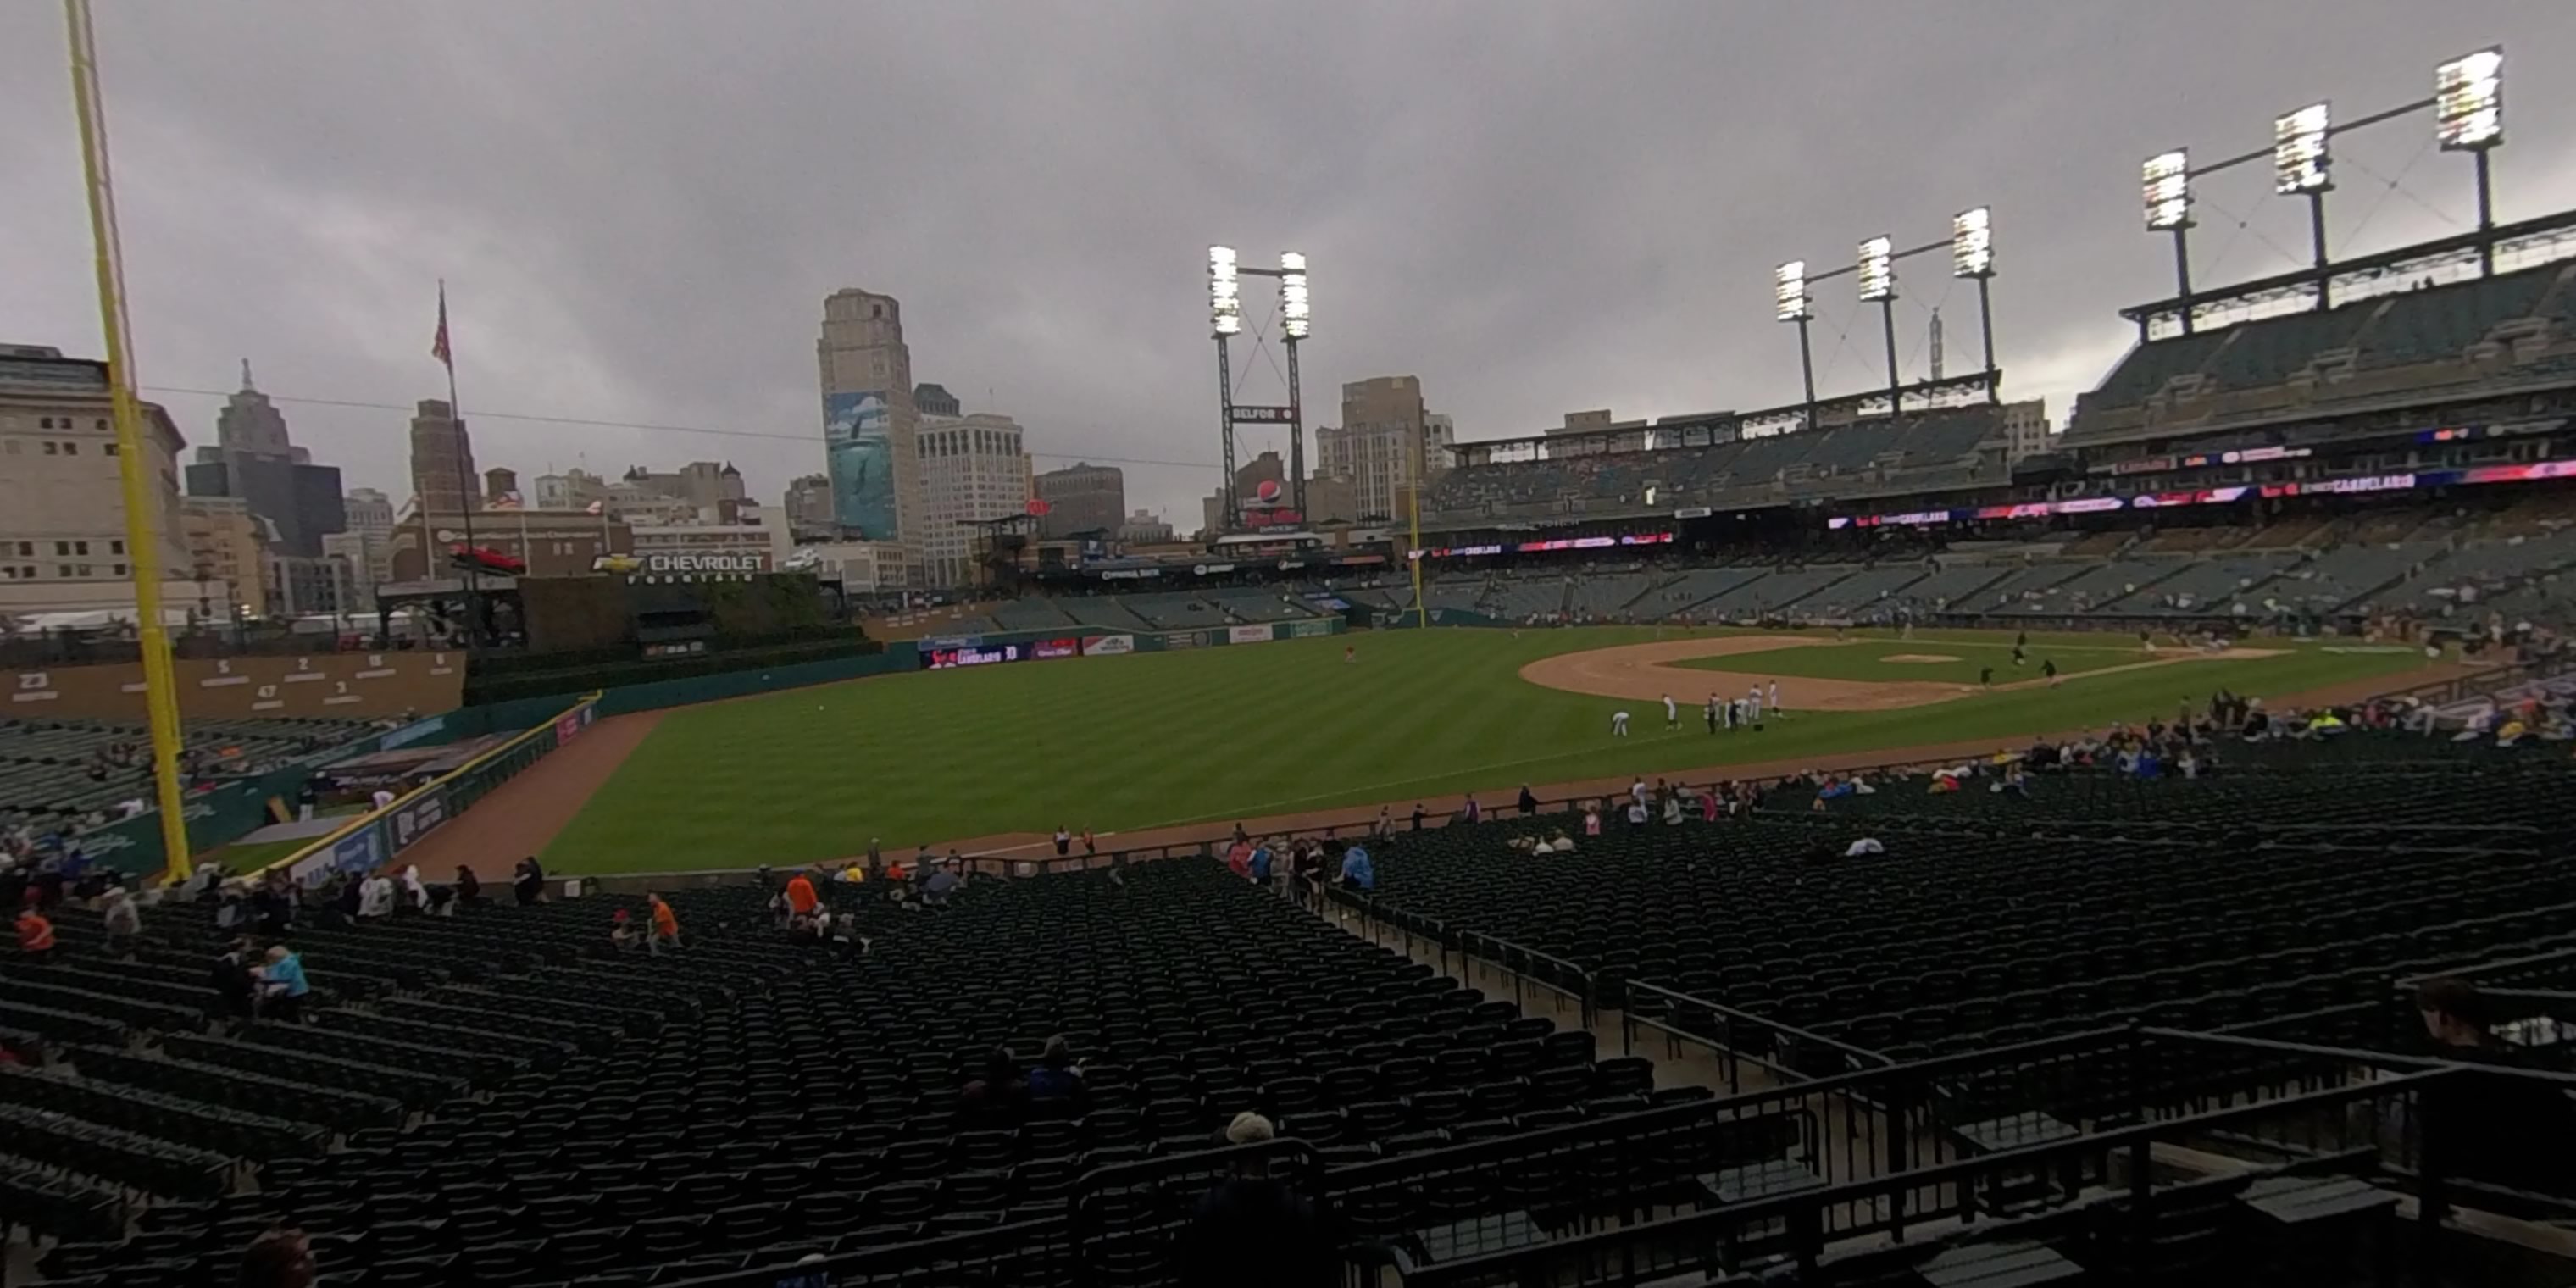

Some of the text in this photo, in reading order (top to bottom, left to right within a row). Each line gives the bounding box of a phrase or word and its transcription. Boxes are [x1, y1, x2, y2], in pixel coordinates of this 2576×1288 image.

[1232, 408, 1275, 419] BELFOR
[650, 556, 763, 571] CHEVROLET
[298, 658, 309, 670] 2
